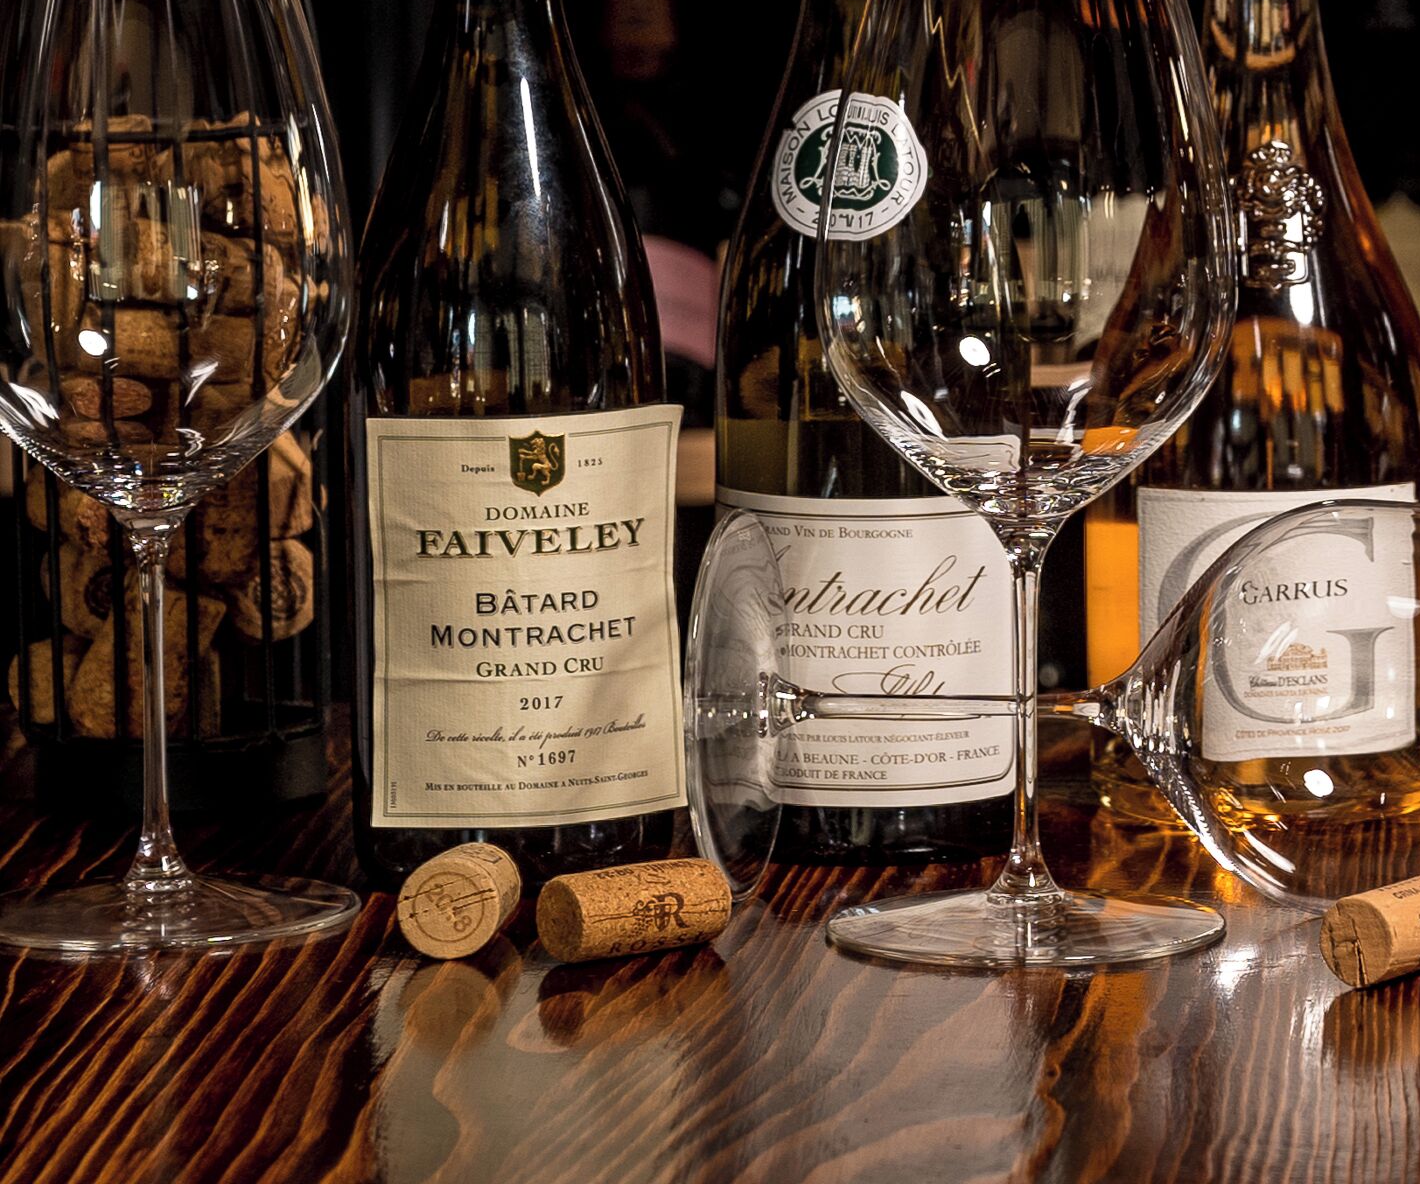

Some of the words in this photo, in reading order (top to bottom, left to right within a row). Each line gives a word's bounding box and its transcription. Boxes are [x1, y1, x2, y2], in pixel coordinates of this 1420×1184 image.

[779, 121, 812, 205] MAISON
[461, 463, 495, 475] Depuis
[485, 502, 590, 522] DOMAINE
[416, 517, 646, 559] FAIVELEY
[475, 588, 600, 617] BÂTARD
[1241, 578, 1348, 606] GARRUS
[431, 616, 637, 650] MONTRACHET
[848, 624, 885, 640] CRU
[893, 639, 982, 659] CONTRÔLÉE
[476, 660, 557, 678] GRAND
[564, 656, 605, 673] CRU
[519, 696, 564, 711] 2017
[425, 728, 446, 743] De
[447, 731, 468, 742] cette
[539, 725, 582, 750] produit
[849, 734, 883, 744] LATOUR
[803, 753, 860, 766] BEAUNE
[870, 751, 946, 766] CÔTE-D'OR
[957, 744, 1001, 762] FRANCE
[425, 782, 442, 792] MIS
[443, 782, 454, 792] EN
[456, 782, 503, 792] BOUTEILLE
[504, 782, 516, 791] AU
[518, 779, 560, 791] DOMAINE
[824, 769, 840, 780] DE
[842, 769, 888, 781] FRANCE
